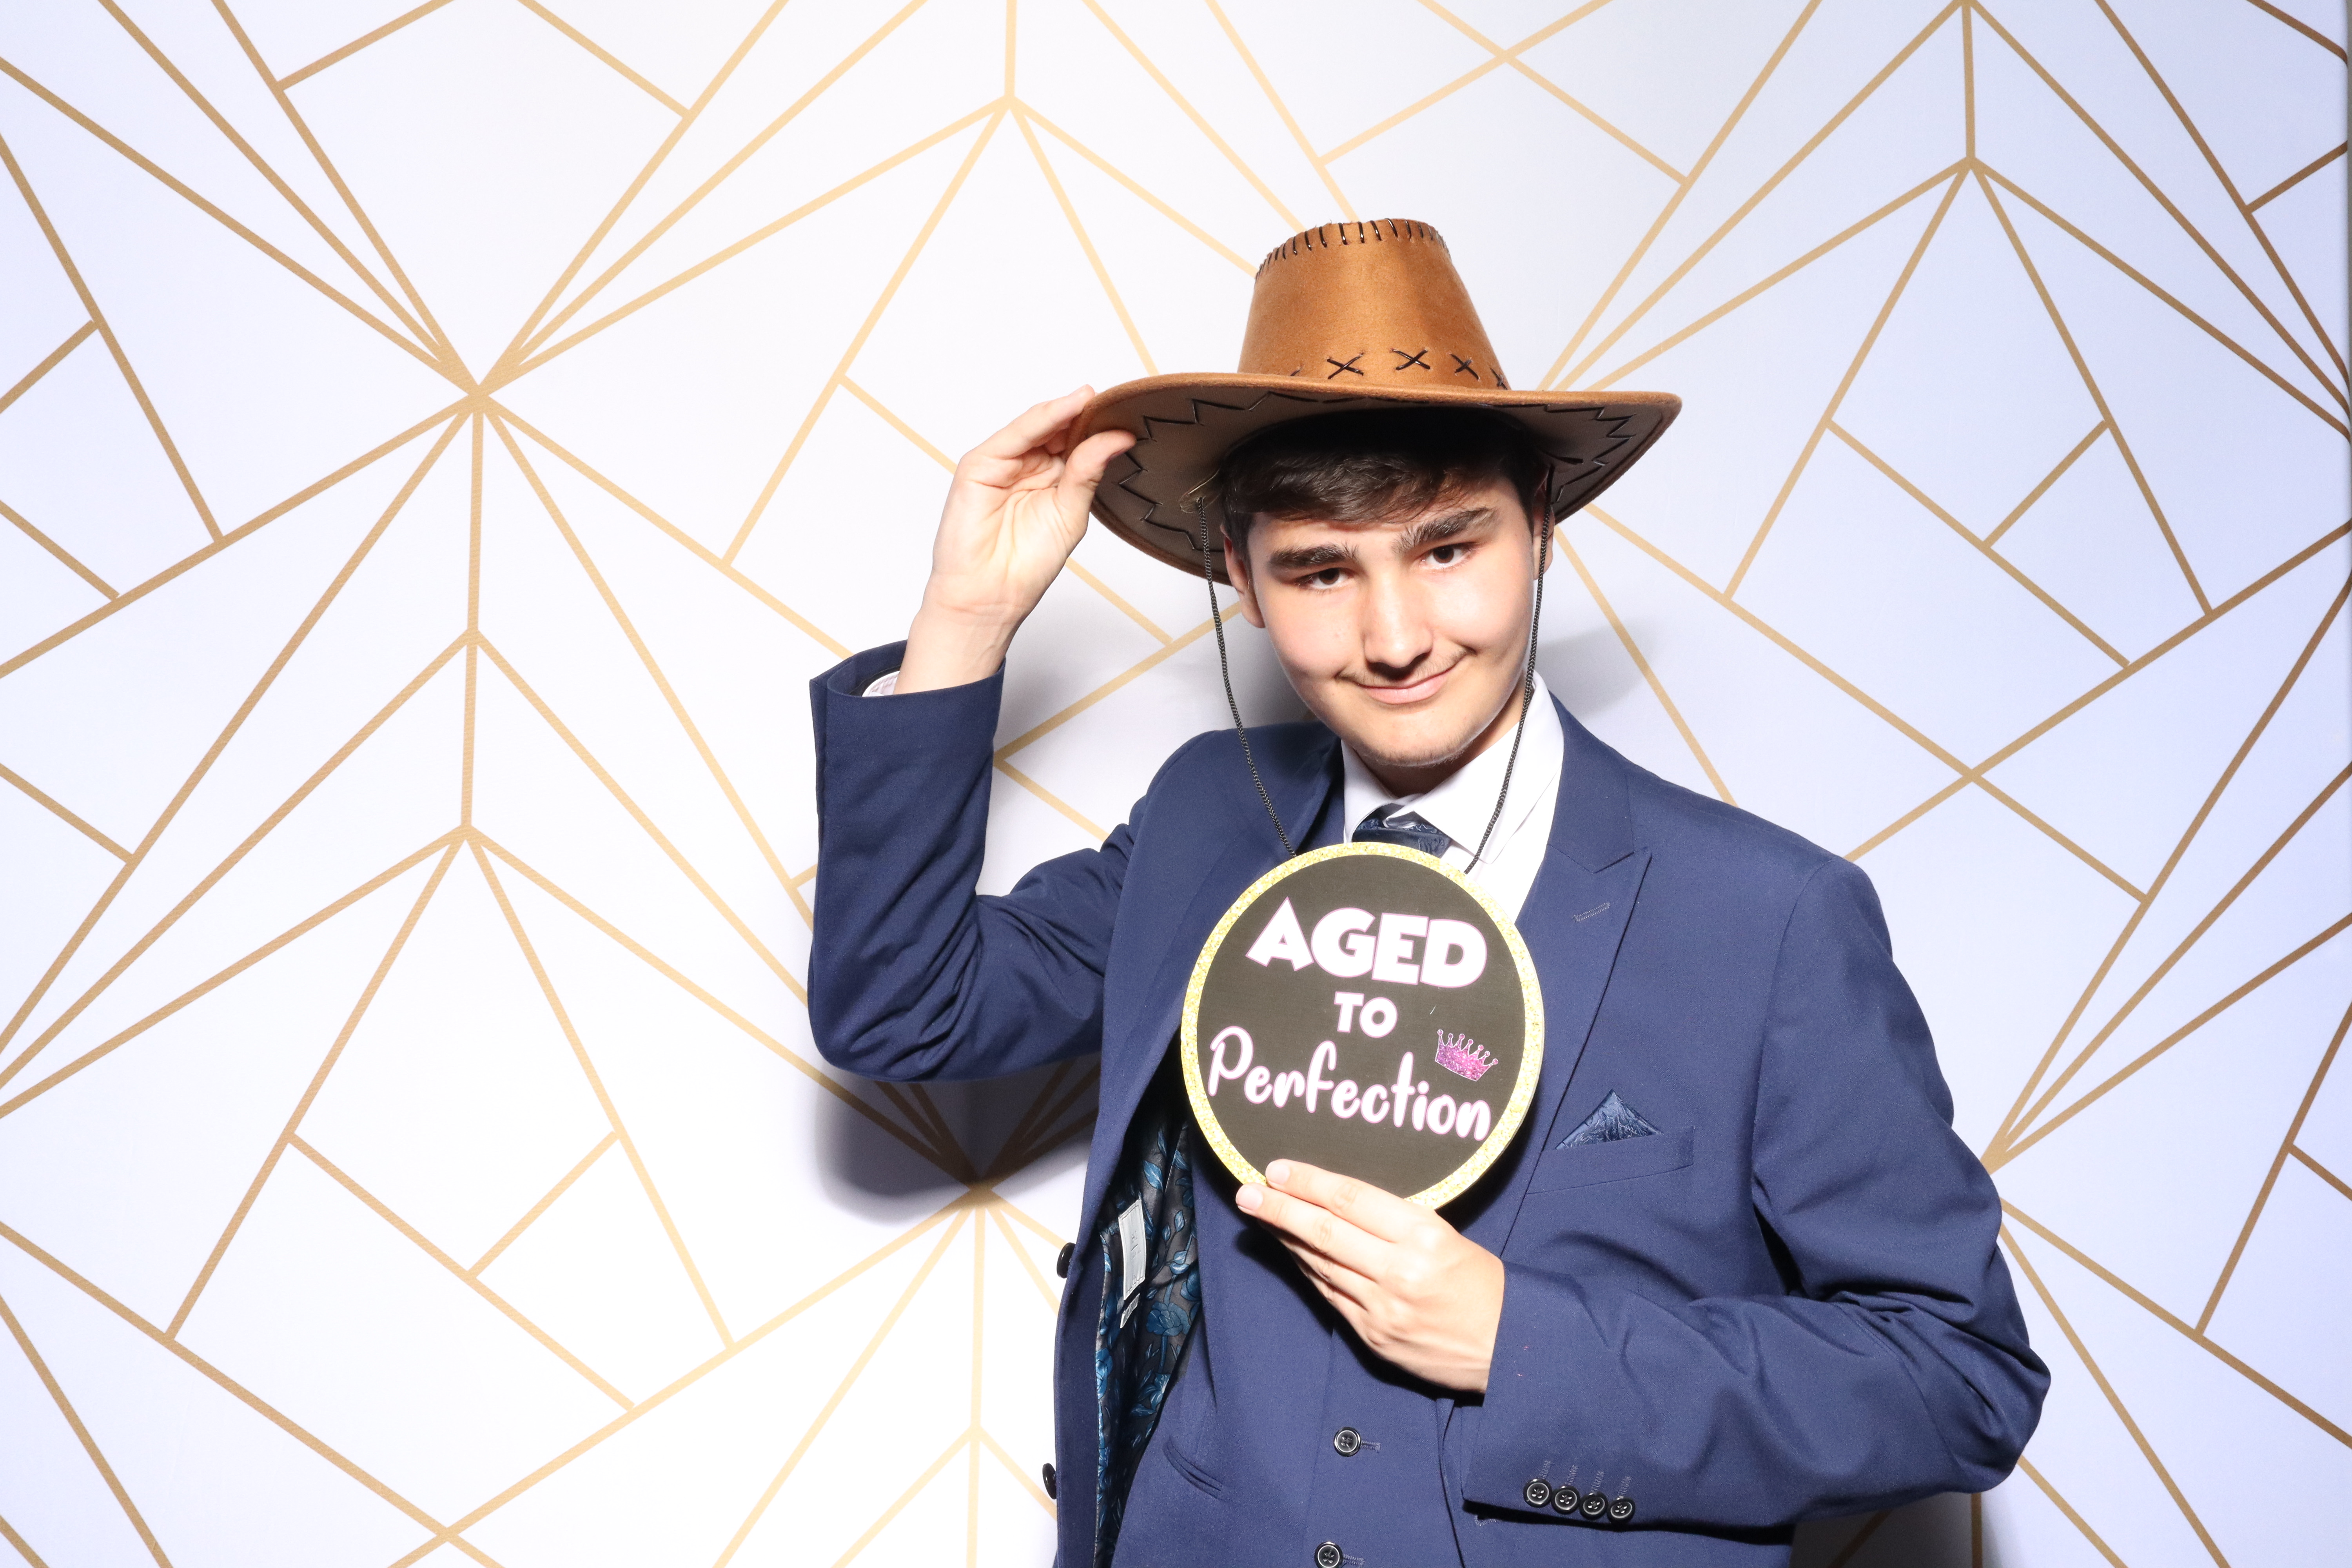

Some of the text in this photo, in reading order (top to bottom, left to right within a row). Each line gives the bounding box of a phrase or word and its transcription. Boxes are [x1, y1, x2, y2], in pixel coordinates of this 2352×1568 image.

[1245, 896, 1487, 988] AGED
[1334, 991, 1398, 1038] TO
[1208, 1025, 1491, 1142] Perfection
